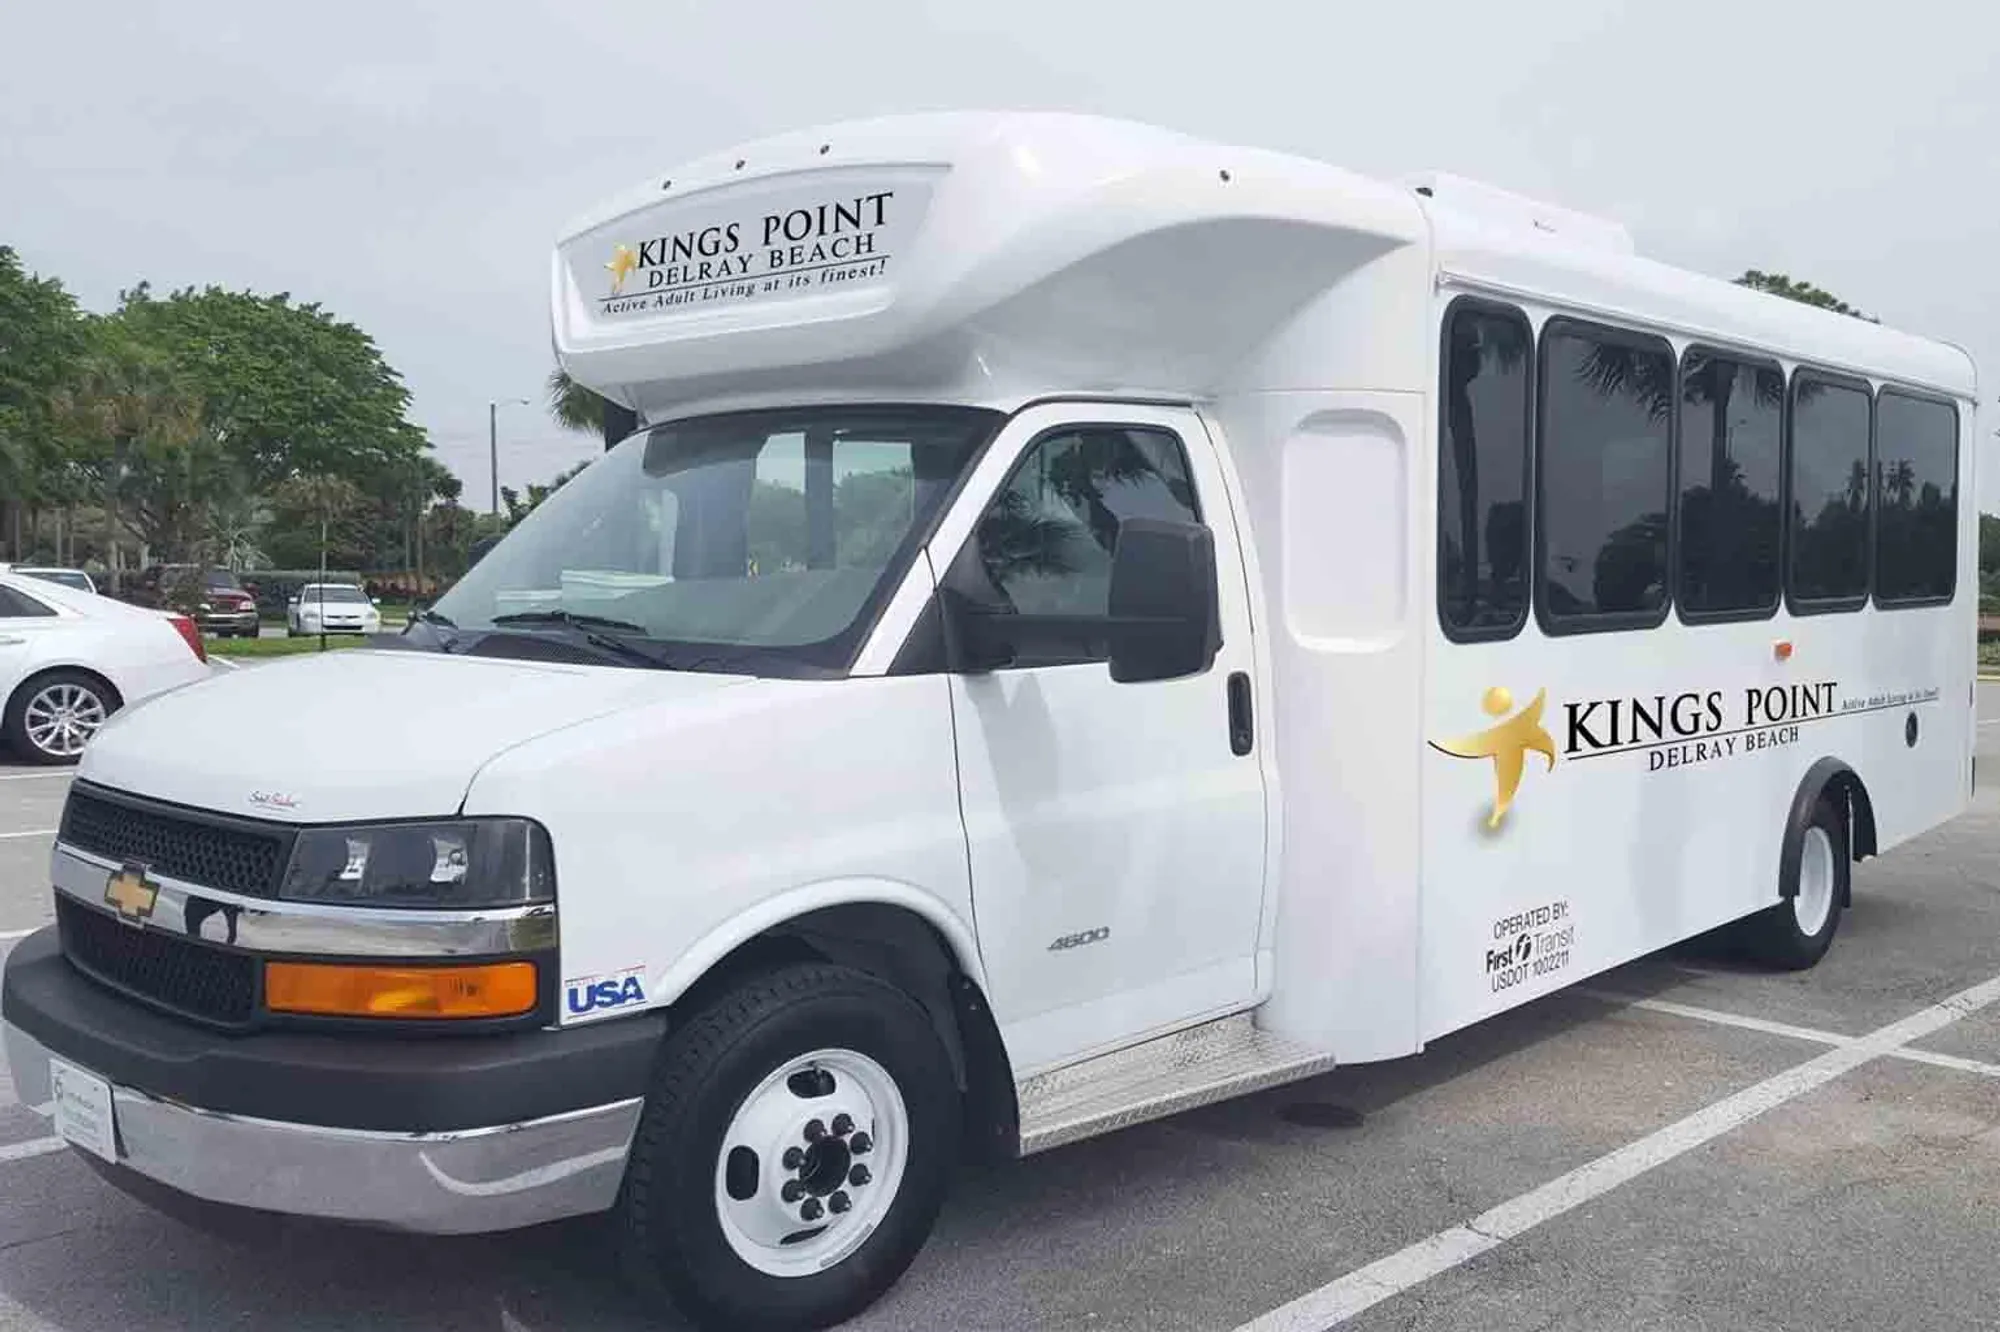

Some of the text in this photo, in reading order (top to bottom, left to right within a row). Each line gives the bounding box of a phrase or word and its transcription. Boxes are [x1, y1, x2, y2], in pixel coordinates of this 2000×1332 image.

[638, 191, 894, 268] KINGS POINT
[649, 233, 875, 288] DELRAY BEACH
[603, 260, 887, 314] Active Adult Living at its finest!
[1563, 681, 1837, 754] KINGS POINT
[1650, 725, 1799, 771] DELRAY BEACH
[1493, 905, 1550, 940] OPERATED
[568, 976, 645, 1013] USA
[1492, 962, 1530, 993] USDOT
